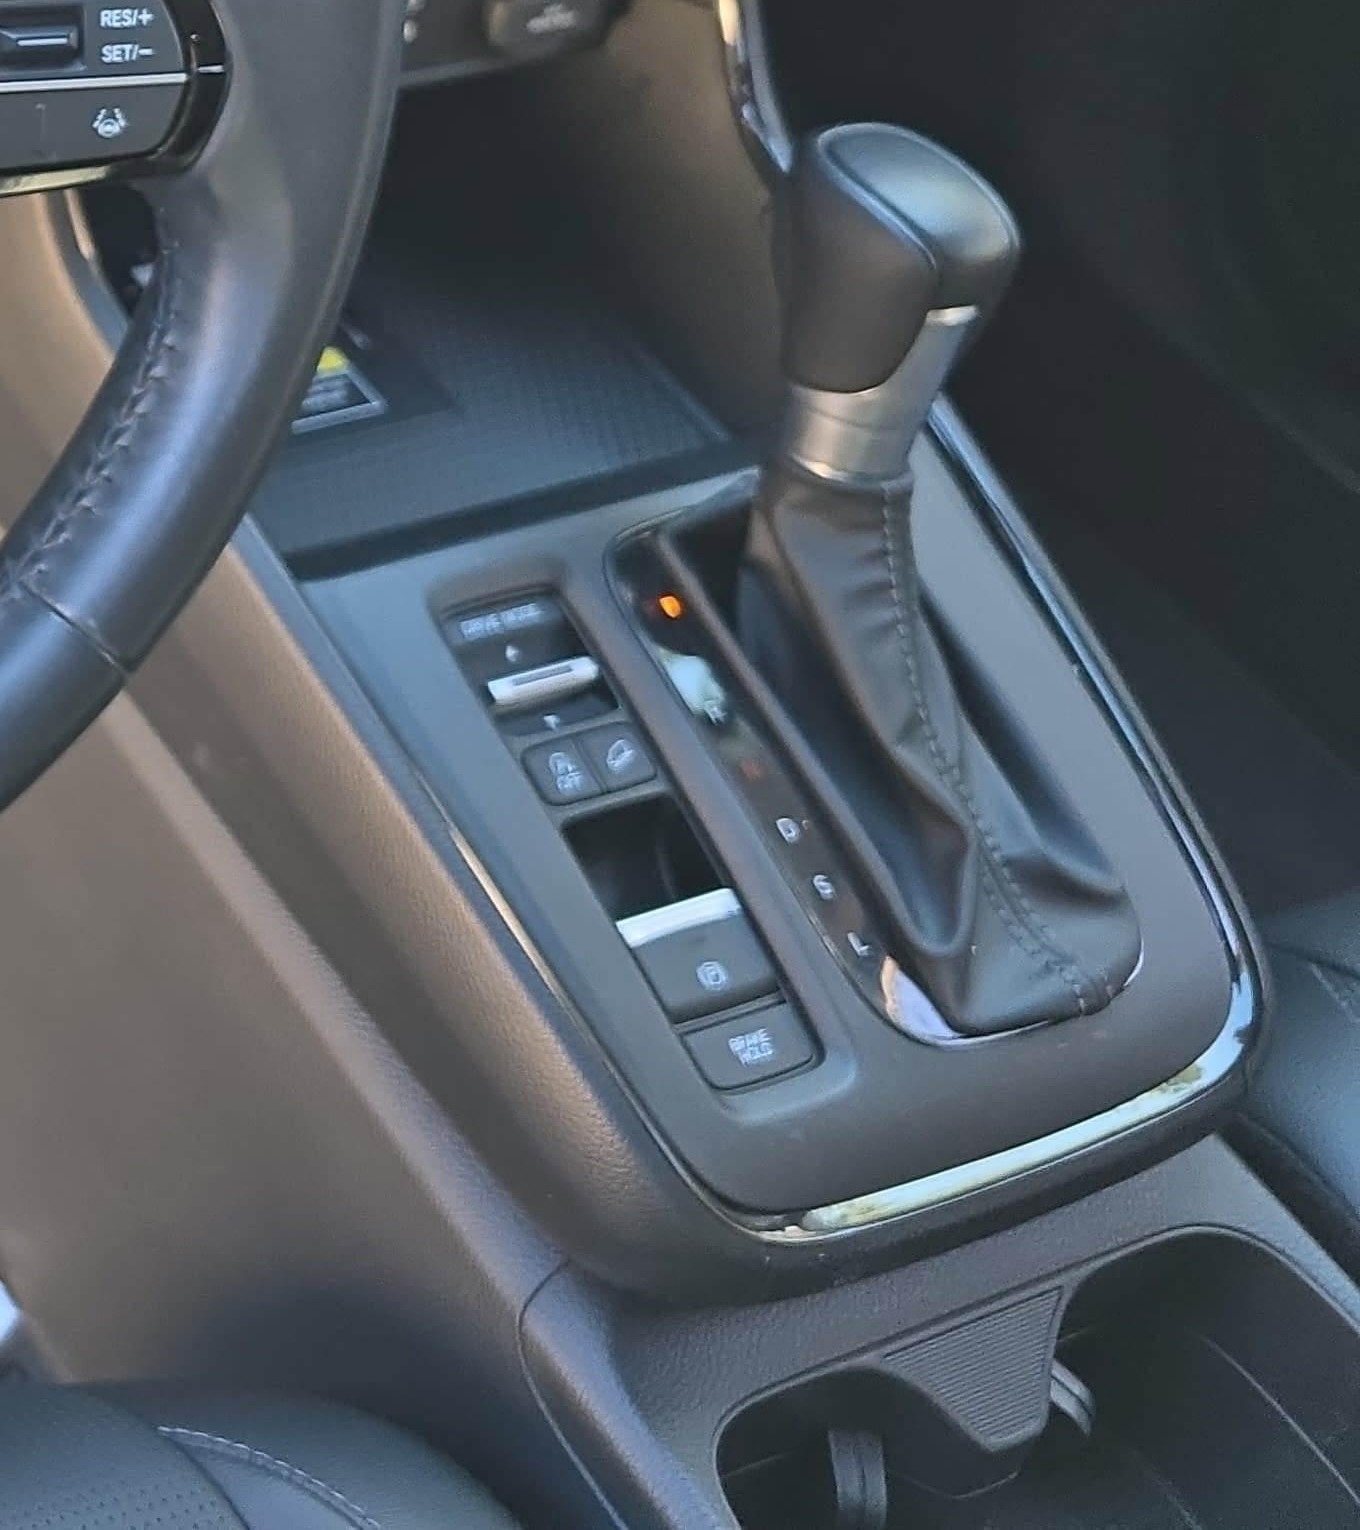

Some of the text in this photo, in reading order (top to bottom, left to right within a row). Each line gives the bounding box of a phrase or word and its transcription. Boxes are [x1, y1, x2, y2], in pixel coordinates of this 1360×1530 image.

[99, 8, 155, 28] RES/+
[100, 44, 155, 63] SET/-
[776, 816, 801, 843] D
[812, 873, 835, 900] S
[847, 931, 871, 957] L
